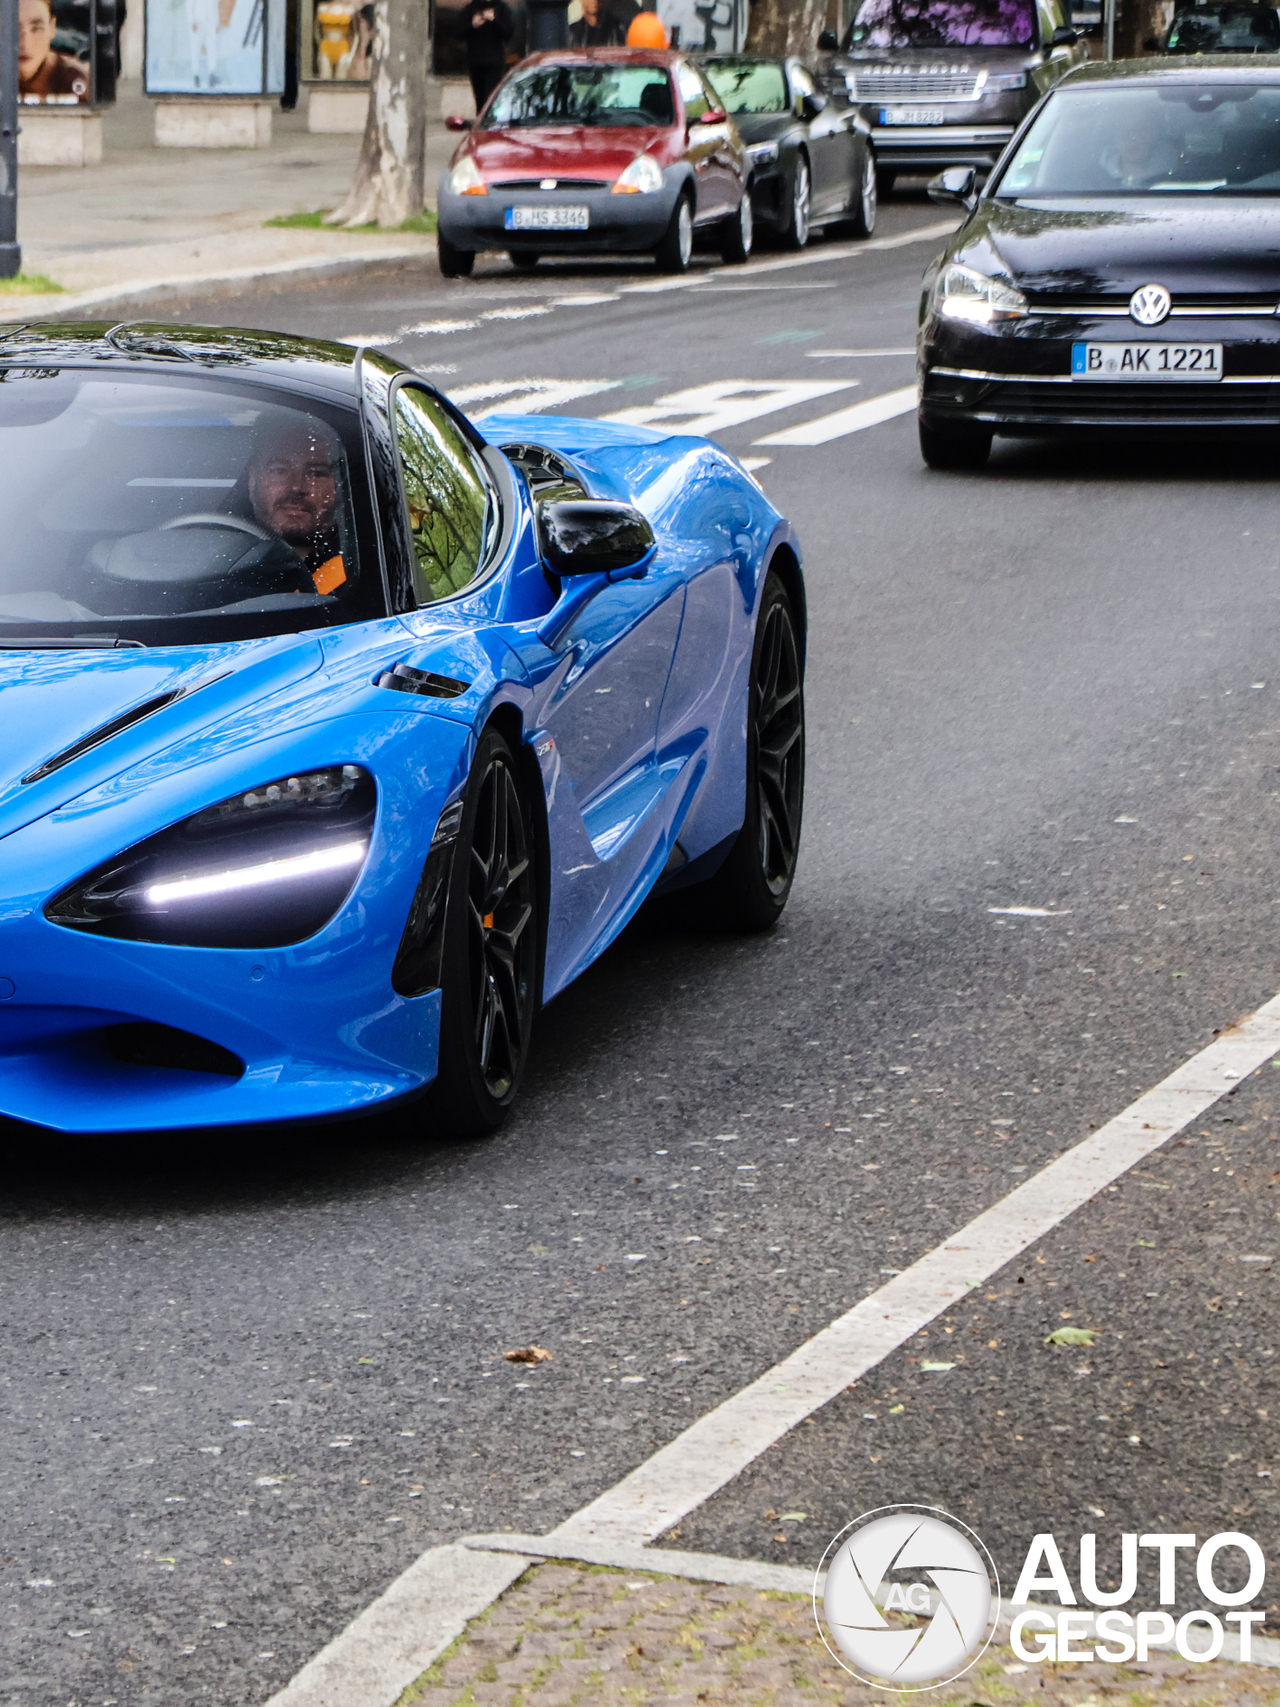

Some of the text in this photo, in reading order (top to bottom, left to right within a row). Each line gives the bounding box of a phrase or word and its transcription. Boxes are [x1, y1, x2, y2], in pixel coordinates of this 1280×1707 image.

[862, 64, 969, 75] RANGE ROVER
[886, 112, 894, 123] B
[514, 211, 523, 225] B
[552, 211, 586, 225] 3346
[1088, 348, 1218, 371] B AK 1221
